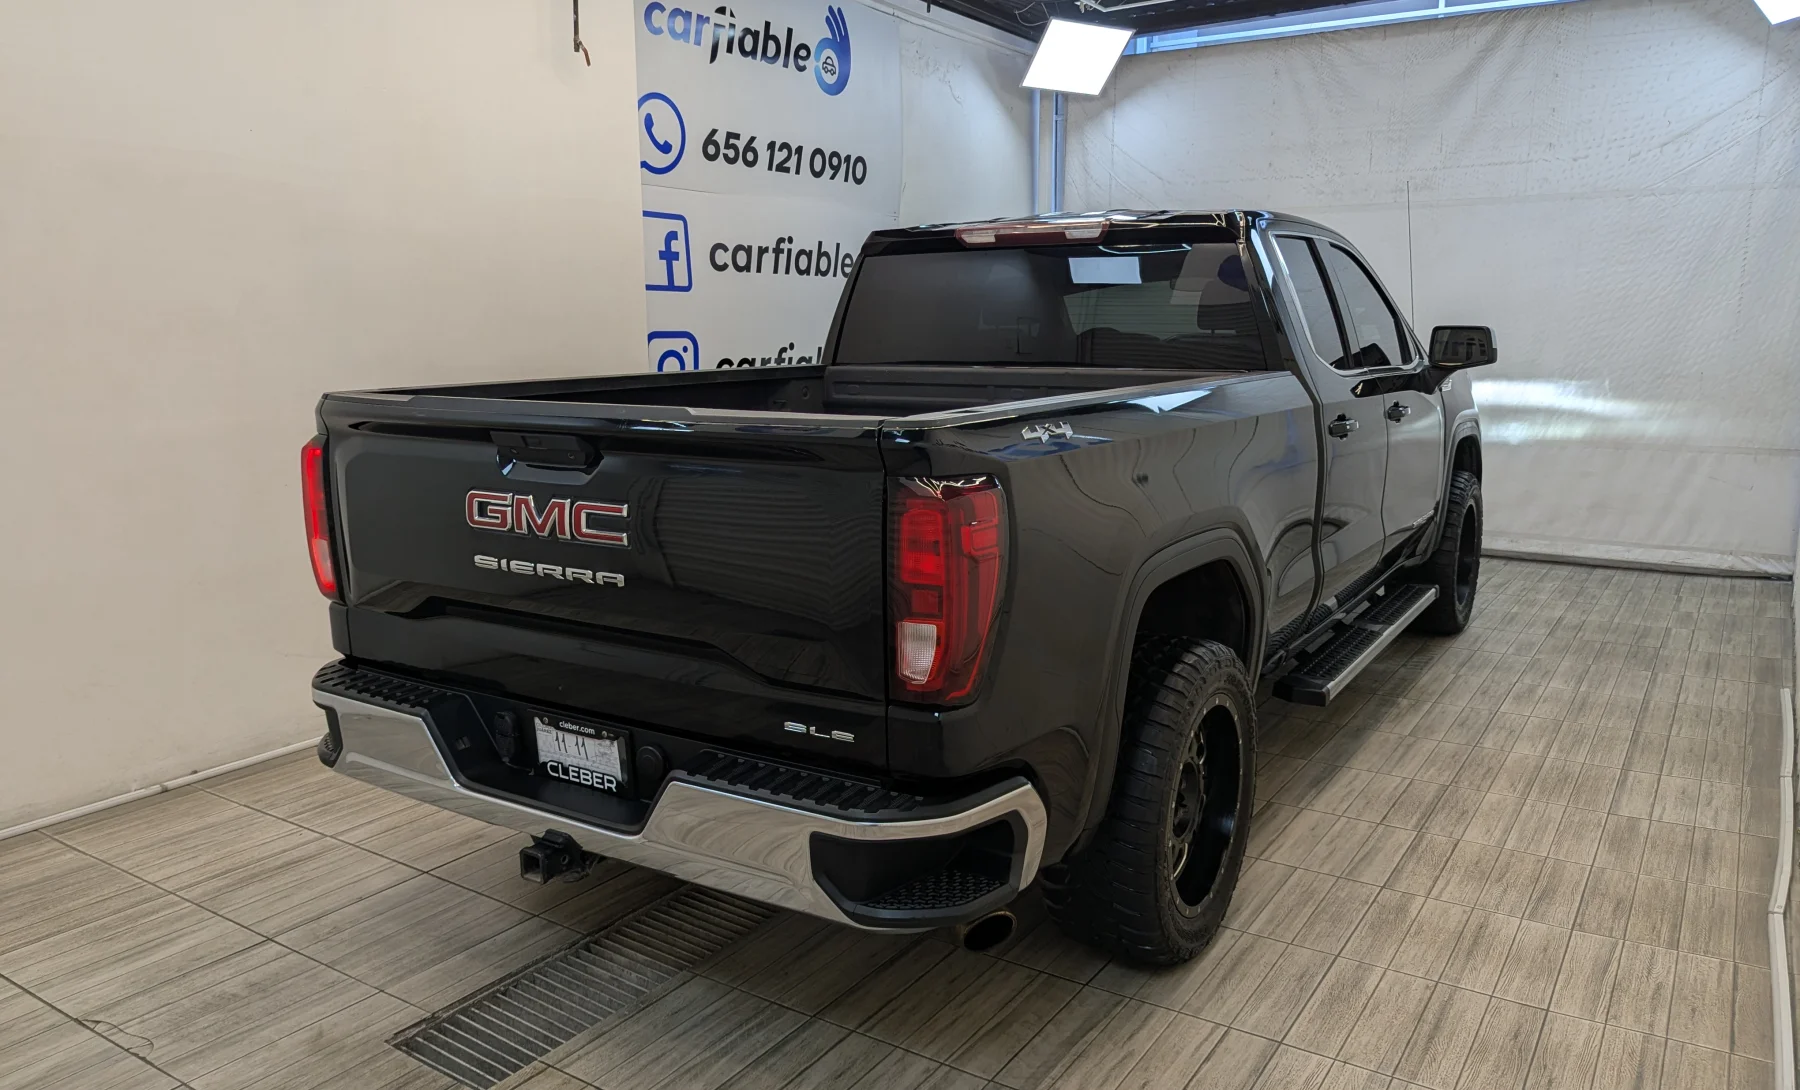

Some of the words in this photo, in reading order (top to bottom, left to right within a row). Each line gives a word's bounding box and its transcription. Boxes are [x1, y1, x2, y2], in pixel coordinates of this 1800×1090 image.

[644, 2, 811, 72] carfiable
[702, 128, 759, 169] 656
[766, 140, 803, 175] 121
[809, 147, 867, 185] 0910
[466, 490, 628, 546] GMC
[474, 554, 625, 587] SIERRA
[559, 721, 595, 735] cleber.com
[784, 721, 855, 742] SLE
[547, 761, 617, 792] CLEBER
